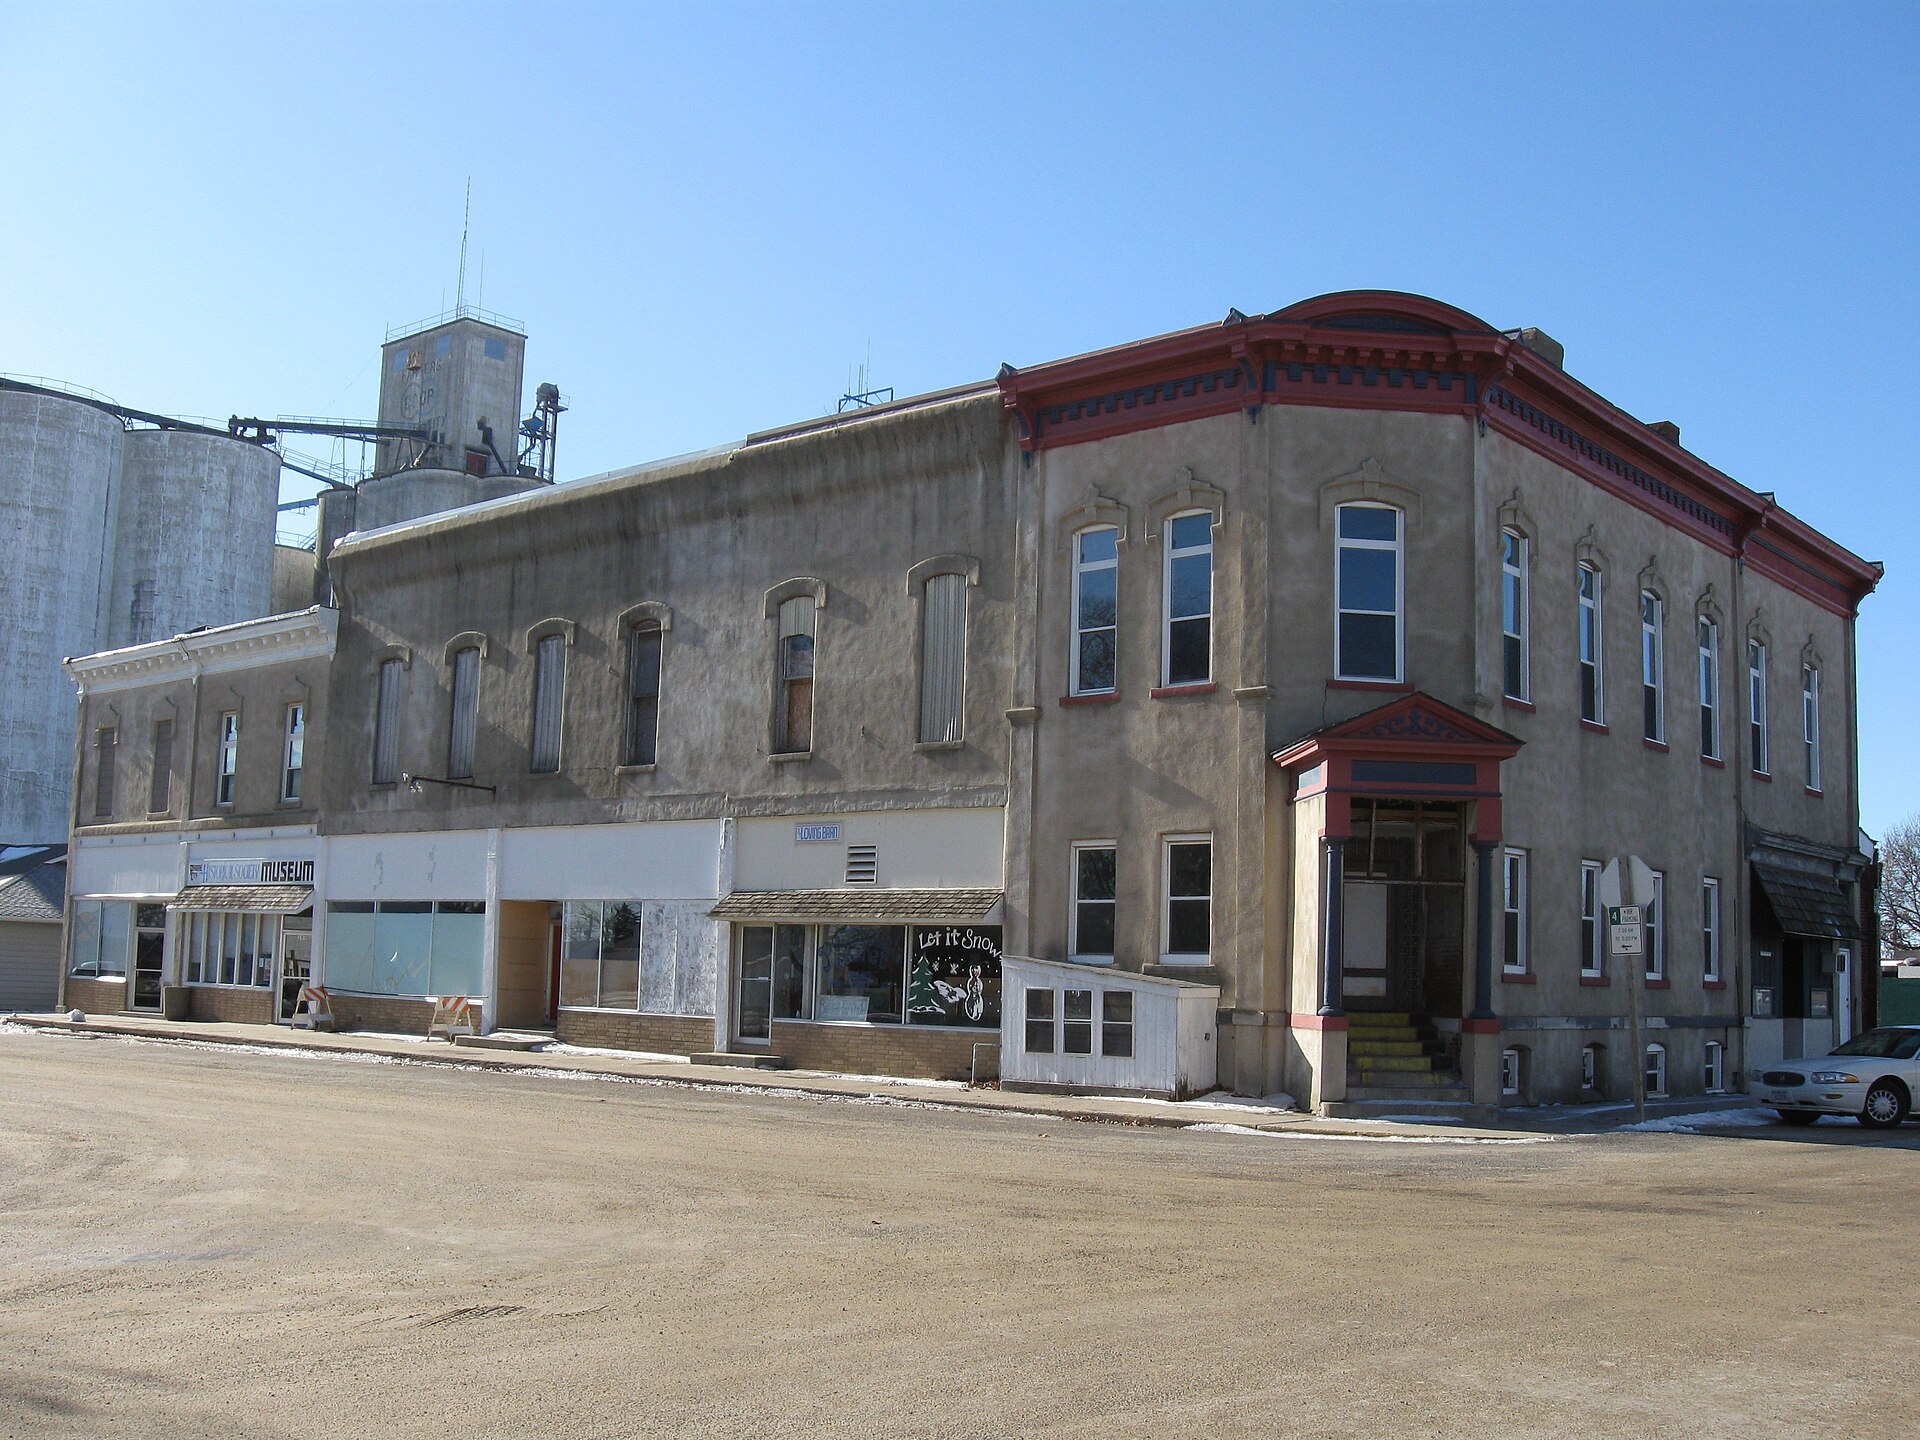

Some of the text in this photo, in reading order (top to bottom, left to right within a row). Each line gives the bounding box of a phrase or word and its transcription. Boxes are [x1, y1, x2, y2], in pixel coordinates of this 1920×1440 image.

[261, 861, 314, 881] MUSEUM
[1612, 912, 1617, 921] 4
[919, 930, 942, 950] Let
[945, 926, 961, 946] it
